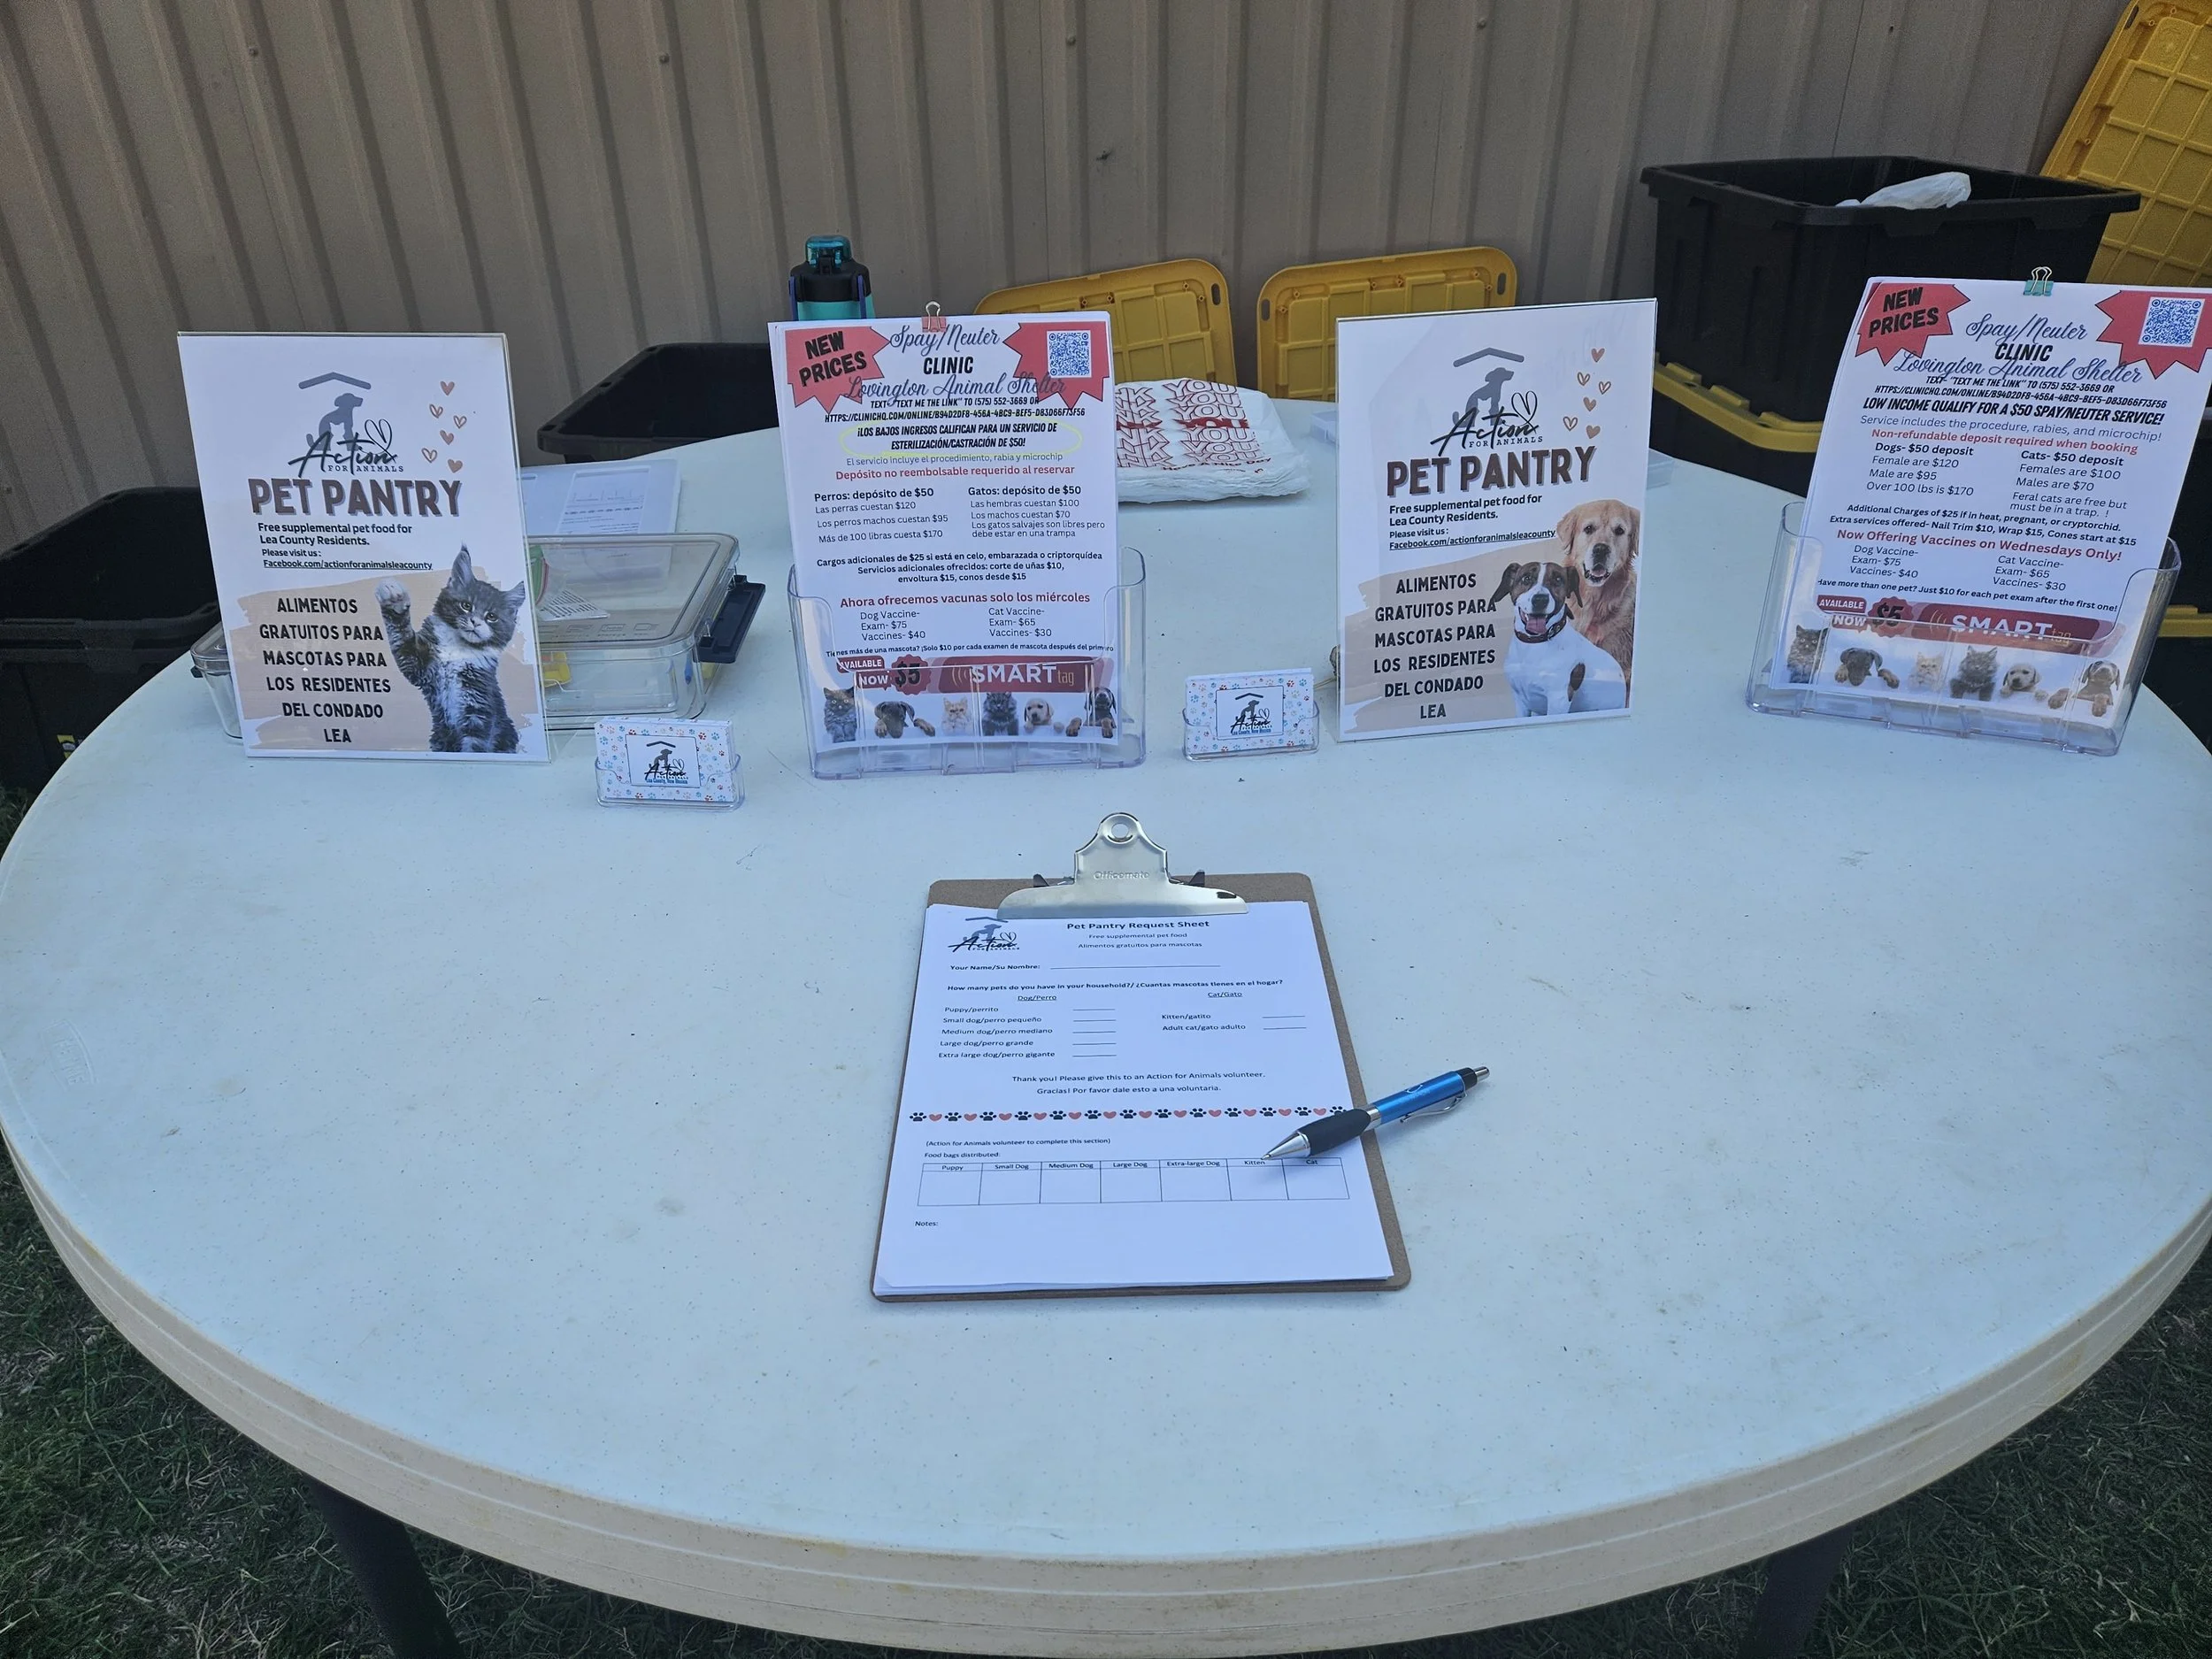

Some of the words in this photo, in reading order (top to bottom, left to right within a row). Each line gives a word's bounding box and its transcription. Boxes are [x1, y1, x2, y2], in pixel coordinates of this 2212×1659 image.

[1883, 287, 1923, 311] NEW
[1869, 308, 1939, 338] PRICES
[1965, 313, 2088, 346] Spay/Neuter
[804, 330, 845, 360] NEW
[889, 324, 1000, 357] Spay/Neuter
[1994, 343, 2054, 361] CLINIC
[799, 351, 867, 388] PRICES
[923, 357, 974, 375] CLINIC
[1893, 351, 1984, 382] Lovington
[1988, 352, 2069, 381] Animal
[2072, 357, 2142, 383] Shelter
[842, 375, 929, 406] Lovington
[933, 373, 1005, 401] Animal
[1007, 373, 1066, 396] Shelter
[1163, 379, 1239, 398] YOU
[1166, 392, 1240, 407] YOU
[1170, 404, 1245, 419] YOU
[1863, 397, 1887, 410] LOW
[1887, 398, 1929, 412] INCOME
[1932, 401, 1975, 415] QUALIFY
[1977, 403, 1998, 415] FOR
[1999, 404, 2008, 415] A
[2010, 403, 2032, 418] $50
[2033, 406, 2112, 423] SPAY/NEUTER
[2114, 411, 2164, 426] SERVICE!
[856, 426, 874, 437] ¡LOS
[874, 426, 900, 437] BAJOS
[901, 425, 938, 435] INGRESOS
[939, 424, 977, 434] CALIFICAN
[978, 423, 998, 434] PARA
[999, 423, 1011, 434] UN
[1012, 422, 1047, 434] SERVICIO
[1047, 422, 1058, 433] DE
[1431, 406, 1539, 456] Action
[890, 435, 996, 450] ESTERILIZACIÓN/CASTRACIÓN
[997, 437, 1009, 448] DE
[1008, 436, 1026, 448] $50!
[1496, 435, 1543, 446] ANIMALS
[1875, 442, 1906, 454] Dogs-
[1908, 442, 1930, 454] $50
[1932, 444, 1975, 457] deposit
[288, 431, 397, 477] Action
[1871, 455, 1910, 466] Female
[1911, 458, 1930, 467] are
[1932, 457, 1960, 468] $120
[2021, 449, 2051, 461] Cats-
[2053, 451, 2077, 463] $50
[2078, 454, 2124, 466] deposit
[835, 469, 882, 482] Depósito
[899, 466, 969, 478] reembolsable
[971, 465, 1020, 478] requerido
[1022, 465, 1032, 474] al
[1386, 457, 1451, 497] PET
[1460, 446, 1596, 492] PANTRY
[248, 478, 311, 516] PET
[323, 480, 464, 518] PANTRY
[814, 493, 850, 503] Perros:
[852, 488, 897, 502] depósito
[899, 488, 912, 497] de
[914, 487, 934, 498] $50
[1389, 504, 1412, 515] Free
[1413, 497, 1482, 513] supplemental
[1483, 497, 1501, 510] pet
[1502, 494, 1525, 506] food
[1526, 494, 1543, 504] for
[1389, 518, 1408, 526] Lea
[1409, 514, 1446, 526] County
[1447, 510, 1498, 523] Residents.
[257, 522, 280, 532] Free
[281, 522, 351, 534] supplemental
[351, 524, 371, 535] pet
[371, 523, 396, 534] food
[396, 523, 412, 534] for
[259, 534, 278, 544] Lea
[279, 534, 316, 547] County
[316, 535, 370, 546] Residents.
[1389, 529, 1556, 550] Facebook.com/actionforanimalsleacounty
[1837, 529, 1864, 540] Now
[1866, 531, 1918, 546] Offering
[1921, 534, 1977, 548] Vaccines
[1979, 541, 1996, 549] on
[2000, 540, 2083, 558] Wednesdays
[2085, 548, 2123, 563] Only!
[264, 559, 433, 570] Facebook.com/actionforanimalsleacounty
[1395, 572, 1477, 595] ALIMENTOS
[276, 596, 358, 615] ALIMENTOS
[840, 597, 876, 609] Ahora
[877, 595, 939, 606] ofrecemos
[941, 595, 988, 603] vacunas
[990, 592, 1014, 603] solo
[1016, 592, 1033, 603] los
[1035, 591, 1090, 603] miércoles
[1374, 601, 1454, 622] GRATUITOS
[1457, 595, 1497, 616] PARA
[1818, 598, 1865, 611] AVAILABLE
[1833, 616, 1867, 627] NOW
[1874, 603, 1903, 626] $5
[259, 623, 340, 641] GRATUITOS
[342, 625, 384, 641] PARA
[1374, 626, 1453, 649] MASCOTAS
[1456, 624, 1495, 641] PARA
[1952, 615, 2053, 639] SMART
[263, 649, 344, 666] MASCOTAS
[345, 651, 388, 667] PARA
[1374, 657, 1402, 674] LOS
[1408, 649, 1495, 672] RESIDENTES
[859, 674, 888, 686] NOW
[895, 662, 920, 687] $5
[970, 664, 1057, 685] SMART
[265, 676, 295, 692] LOS
[301, 677, 391, 694] RESIDENTES
[1384, 681, 1410, 698] DEL
[1414, 675, 1484, 695] CONDADO
[281, 702, 311, 717] DEL
[312, 703, 384, 718] CONDADO
[1420, 703, 1447, 719] LEA
[323, 728, 352, 743] LEA
